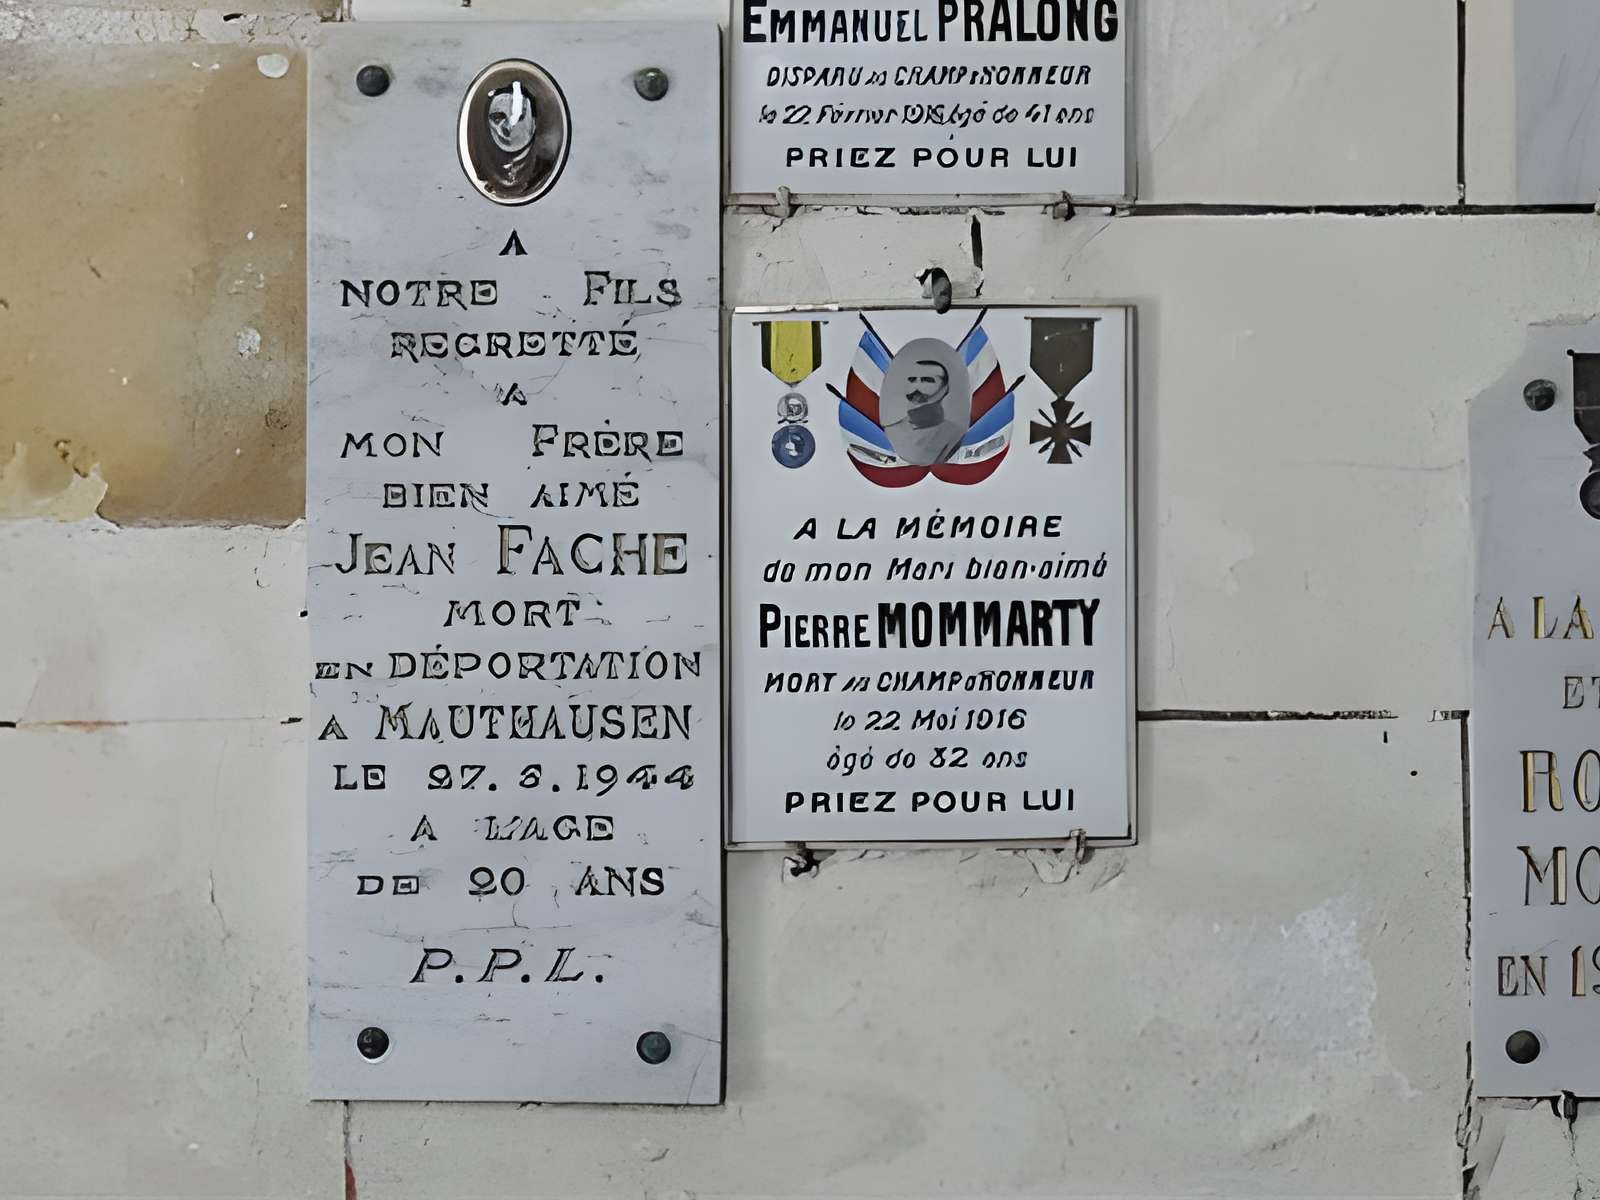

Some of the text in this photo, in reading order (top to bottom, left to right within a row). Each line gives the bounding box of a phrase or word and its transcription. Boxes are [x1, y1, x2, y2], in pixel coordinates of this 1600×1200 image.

[766, 66, 866, 87] DISPARU
[786, 147, 1077, 168] PRIEZ POUR LUI
[499, 230, 528, 256] A
[340, 280, 499, 310] NOTRE
[391, 319, 639, 362] REGRETTÉ
[501, 383, 528, 406] A
[341, 419, 684, 462] MON FRÈRE
[383, 472, 640, 509] BIEN AIMÉ
[793, 508, 1062, 540] A LA MÉMOIRE
[335, 525, 688, 575] JEAN FACHE
[804, 562, 872, 581] mon
[443, 600, 580, 628] MORT
[878, 599, 1100, 648] MOMMARTY
[1487, 597, 1515, 640] A
[1532, 596, 1594, 640] LA
[315, 644, 701, 680] EN DÉPORTATION
[764, 672, 837, 694] MORT
[318, 703, 692, 741] A MAUTHAUSEN
[864, 711, 901, 730] 22
[965, 709, 1027, 729] 1916
[333, 764, 386, 791] LE
[785, 789, 1074, 813] PRIEZ POUR LUI
[410, 815, 438, 841] A
[357, 867, 666, 896] DE 20 ANS
[1497, 956, 1549, 997] EN
